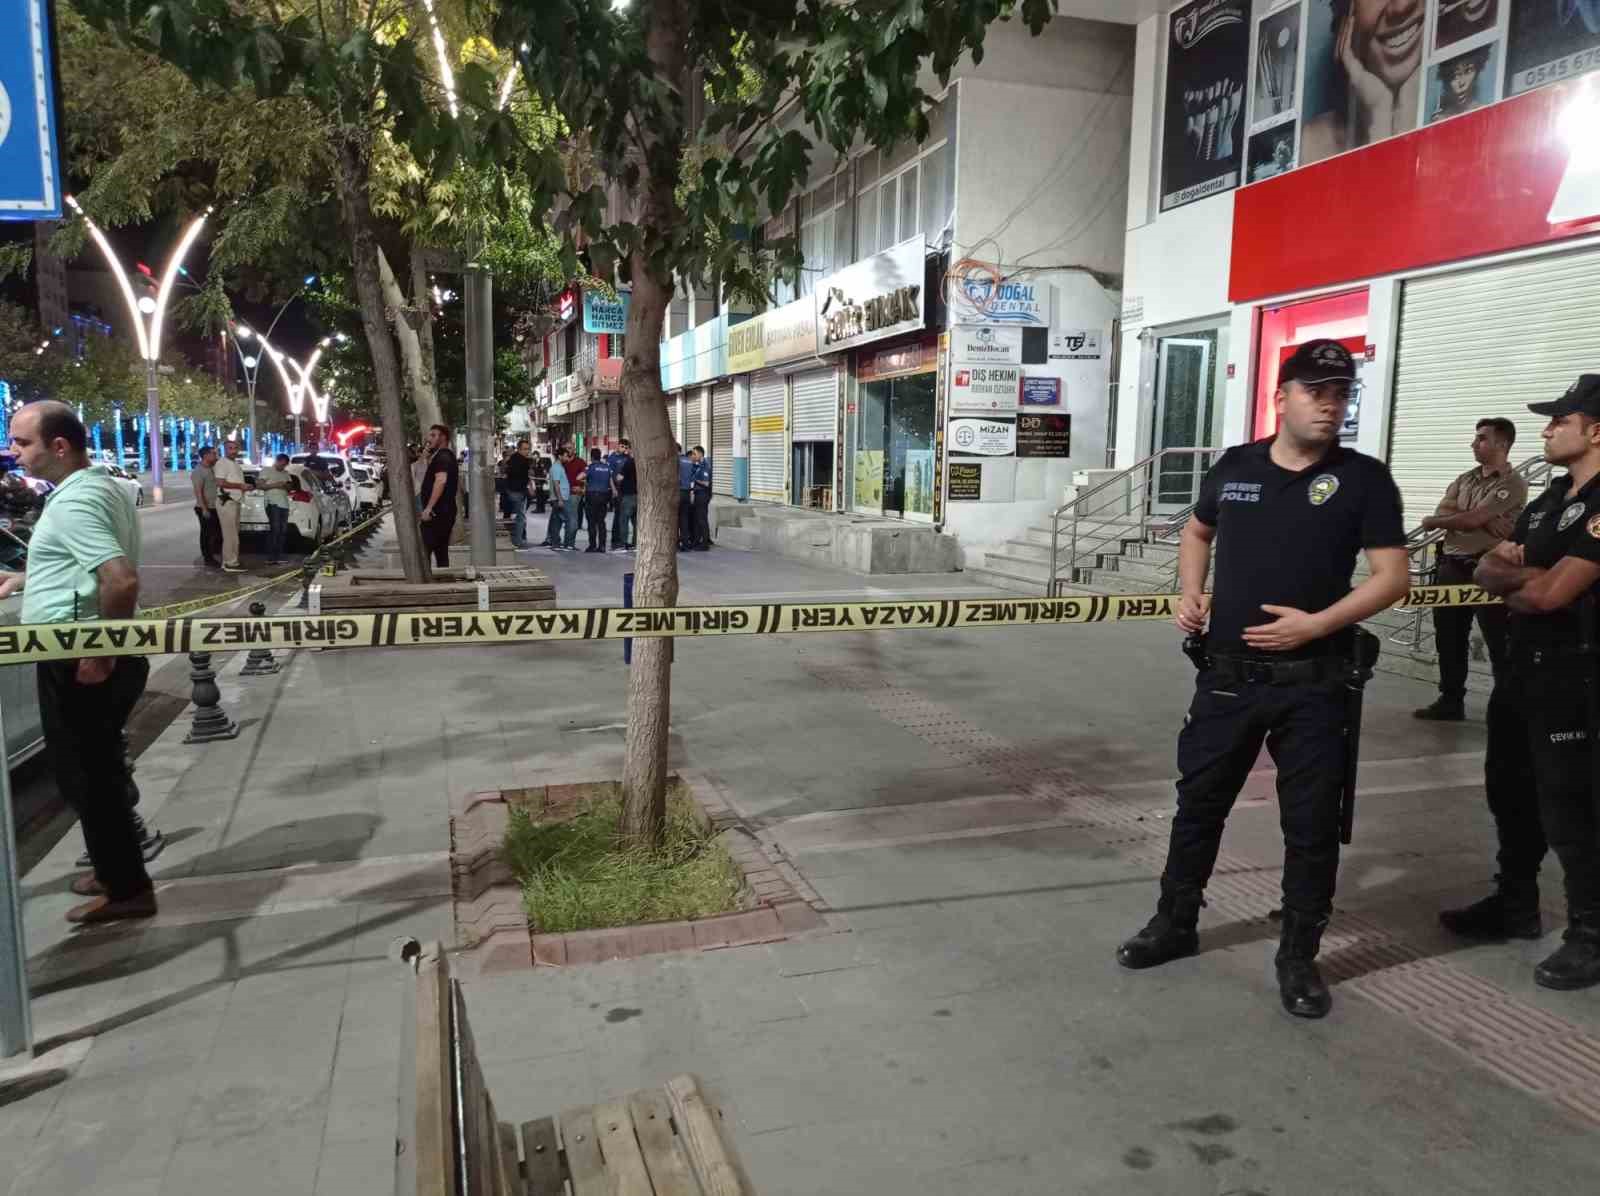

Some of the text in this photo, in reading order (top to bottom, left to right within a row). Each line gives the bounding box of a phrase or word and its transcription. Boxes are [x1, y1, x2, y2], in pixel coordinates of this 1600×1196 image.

[991, 301, 1040, 313] DENTAL
[791, 604, 935, 631] KAZA YERİ
[966, 601, 1080, 623] GİRİLMEZ
[1116, 598, 1172, 618] YERİ
[200, 619, 359, 645] GİRİLMEZ
[410, 613, 580, 643] KAZA YERİ
[616, 609, 750, 634] GİRİLMEZ
[54, 624, 158, 651] KAZA
